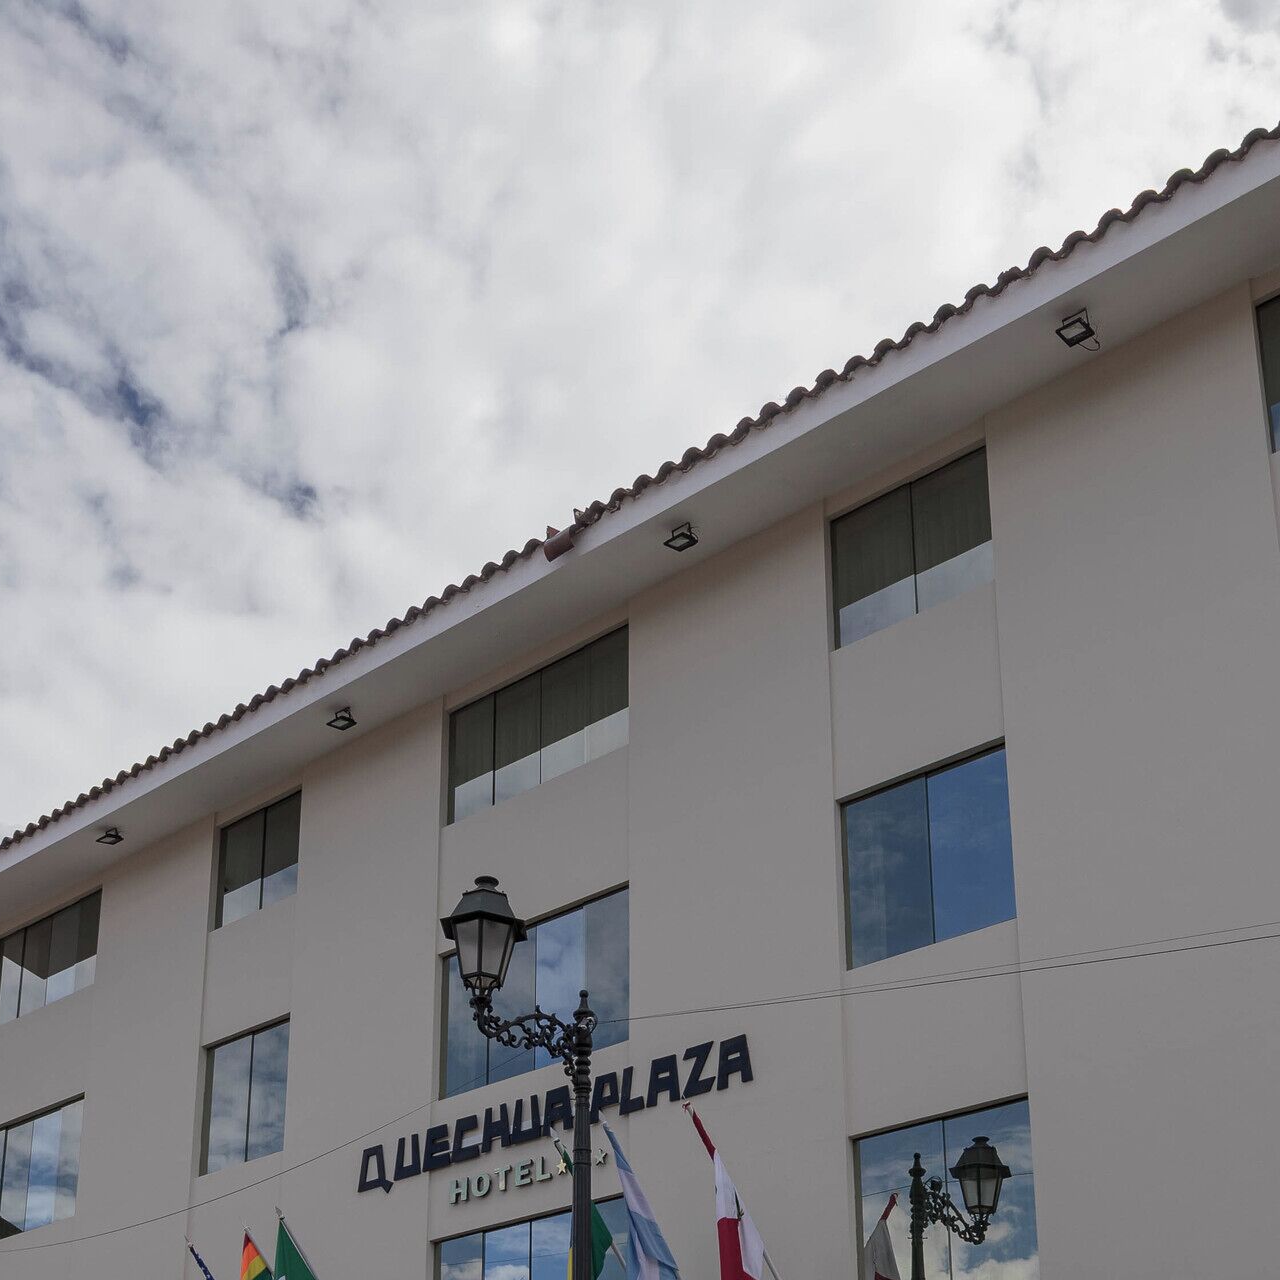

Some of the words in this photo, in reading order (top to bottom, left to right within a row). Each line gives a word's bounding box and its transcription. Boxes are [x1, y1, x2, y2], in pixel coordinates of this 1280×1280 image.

[358, 1085, 574, 1193] QUECHUA
[589, 1033, 754, 1124] PLAZA
[449, 1156, 552, 1204] HOTEL
